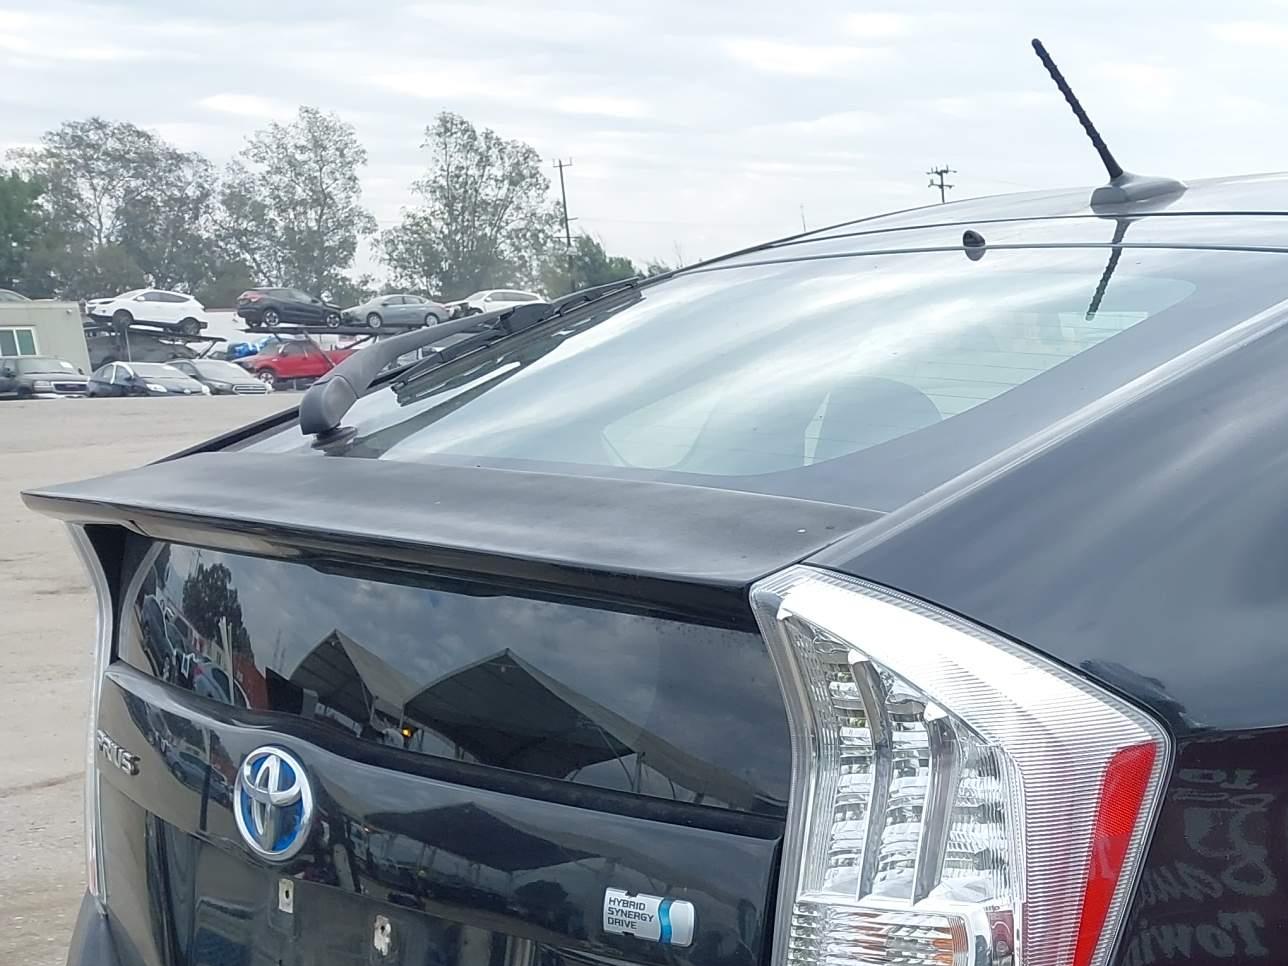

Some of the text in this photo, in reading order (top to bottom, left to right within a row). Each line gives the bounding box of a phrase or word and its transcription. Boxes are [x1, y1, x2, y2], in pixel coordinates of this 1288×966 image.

[608, 896, 646, 911] HYBRID
[607, 906, 655, 922] SYNERGY
[607, 916, 638, 930] DRIVE
